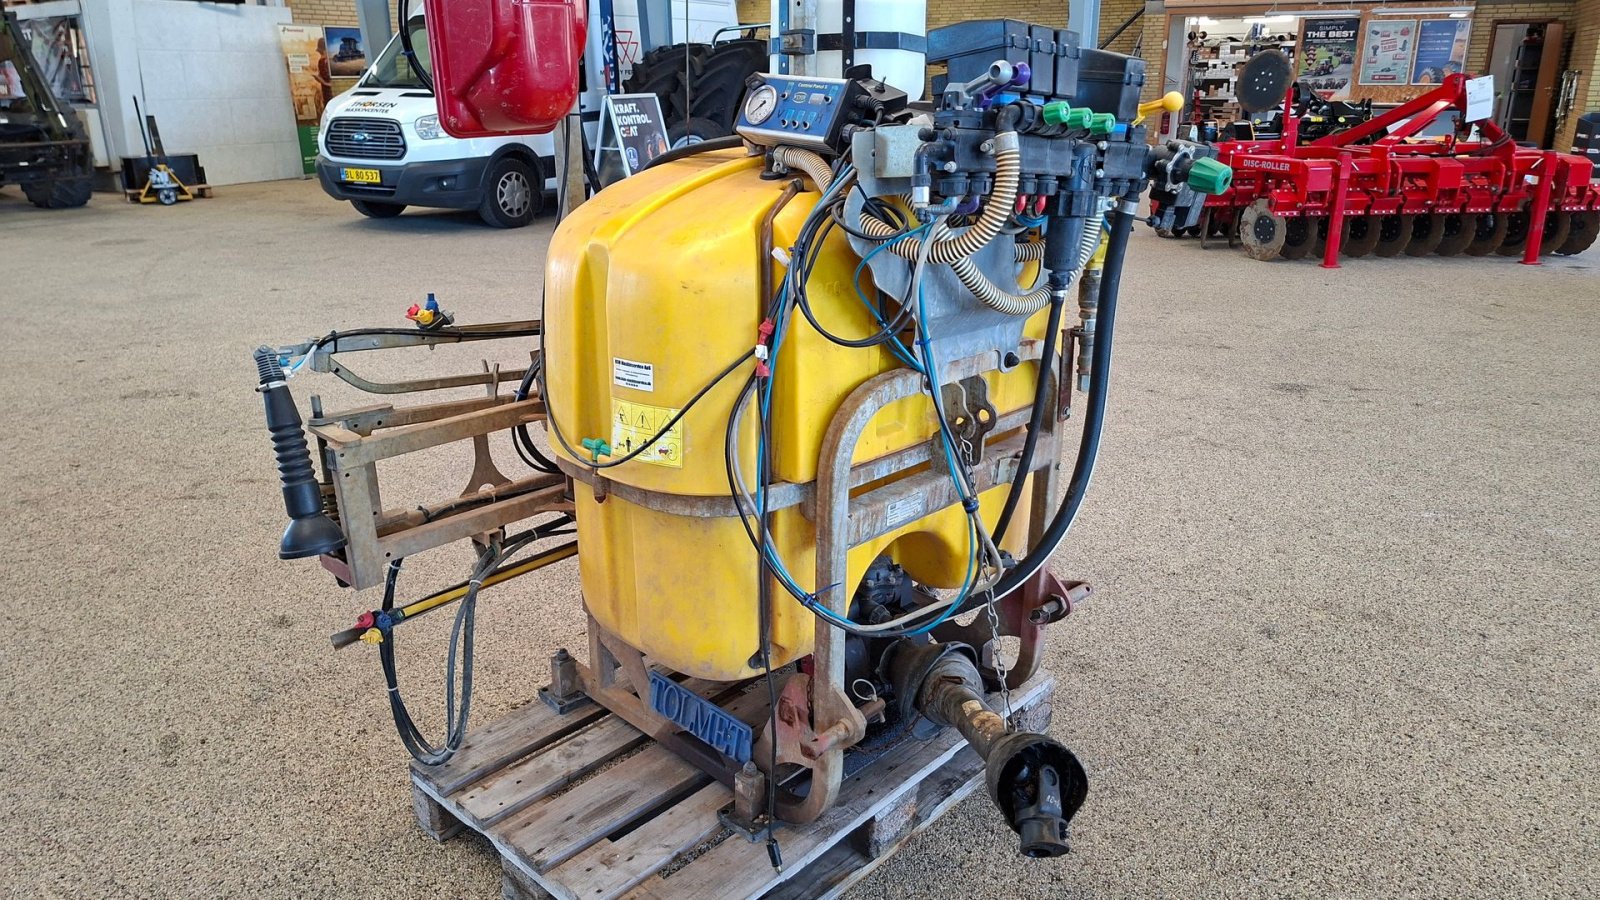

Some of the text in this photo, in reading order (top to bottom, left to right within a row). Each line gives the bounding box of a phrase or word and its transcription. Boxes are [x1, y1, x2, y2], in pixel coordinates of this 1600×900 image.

[614, 103, 640, 114] KRAFT.
[616, 114, 653, 126] KONTROL.
[1243, 159, 1291, 171] DISC-ROLLER
[344, 170, 378, 181] BL 80 537
[651, 677, 748, 760] TOLMET
